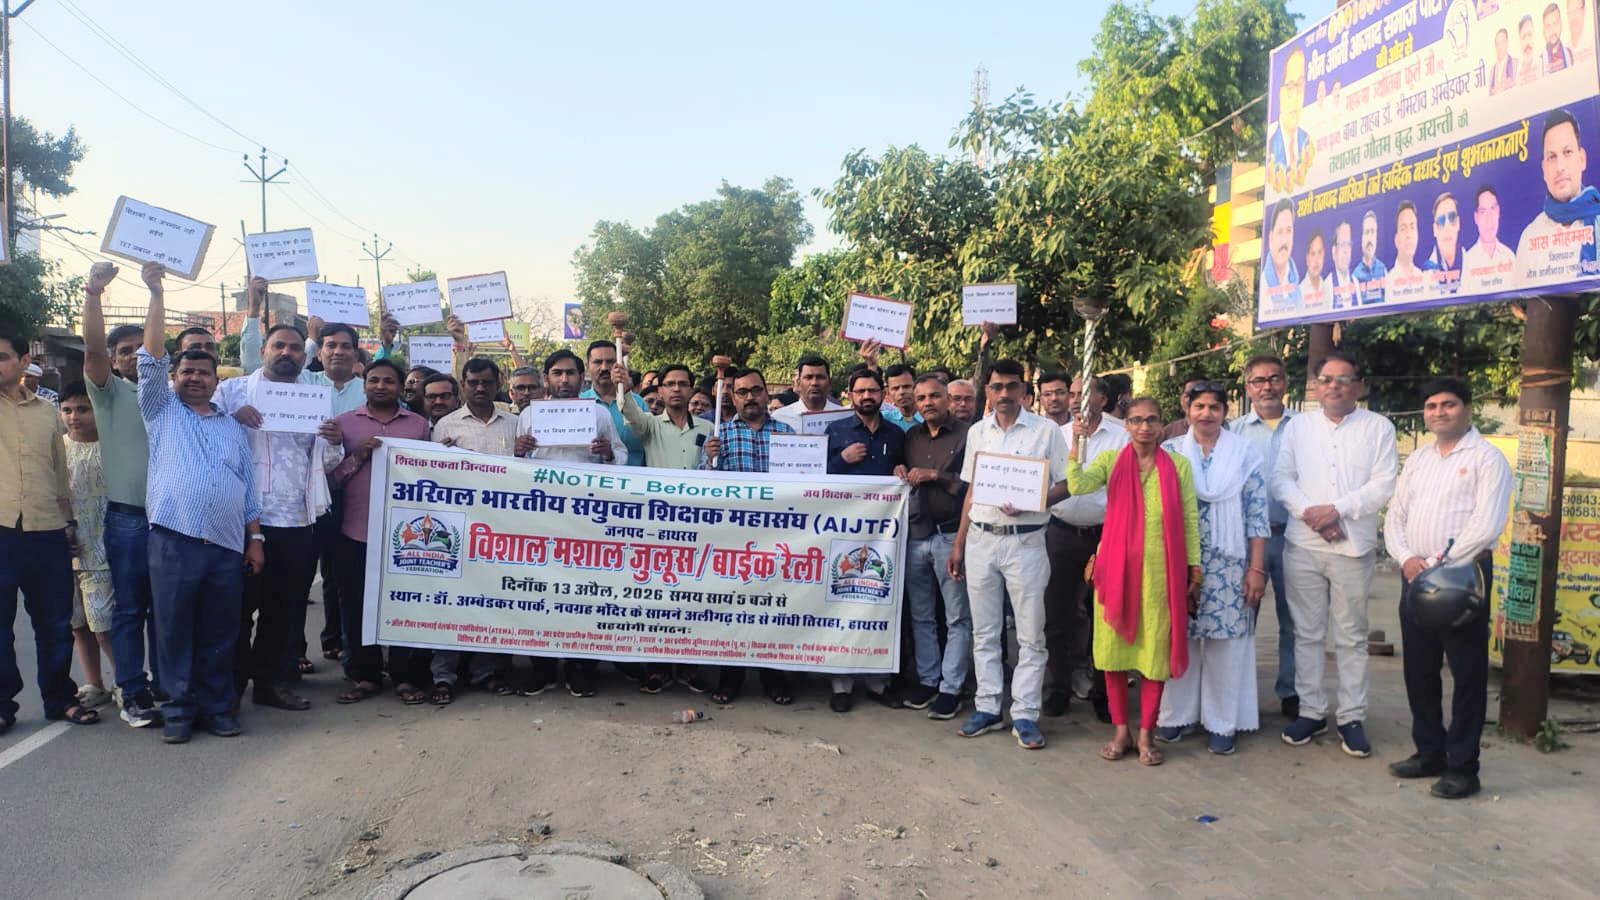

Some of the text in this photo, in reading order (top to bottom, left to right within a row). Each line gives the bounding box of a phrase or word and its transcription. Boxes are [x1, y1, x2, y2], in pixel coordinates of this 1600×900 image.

[1307, 49, 1326, 82] भीम
[1350, 20, 1382, 60] आजाद
[1384, 3, 1417, 40] समाज
[1376, 32, 1413, 68] की ओर से
[1425, 48, 1435, 76] जी
[1343, 120, 1357, 141] बाबा
[1396, 93, 1427, 119] भीमराव
[1431, 74, 1470, 106] अम्बेडकर
[1474, 58, 1486, 88] जी
[1329, 105, 1469, 174] तथागत गौतम बुद्ध जयन्ती की
[1368, 168, 1381, 196] को
[1382, 159, 1412, 193] हार्दिक
[1413, 147, 1442, 182] बधाई
[1442, 144, 1460, 184] एवं
[120, 240, 131, 249] TET
[1528, 235, 1549, 251] आस
[395, 454, 427, 468] शिक्षक
[430, 458, 459, 471] एकता
[533, 468, 774, 500] #NoTET_BeforeRTE
[803, 489, 819, 498] जय
[822, 488, 852, 499] शिक्षक
[864, 493, 879, 501] जय
[392, 480, 900, 538] अखिल भारतीय संयुक्त शिक्षक महासंघ (AIJTF)
[605, 525, 697, 542] जनपद हाथरस
[423, 551, 445, 559] INDIA
[468, 522, 549, 566] विशाल
[553, 534, 625, 568] मशाल
[777, 543, 826, 582] रैली
[552, 582, 571, 594] 13
[575, 581, 618, 600] अप्रैल,
[623, 586, 663, 600] 2026
[669, 590, 703, 602] समय
[707, 589, 733, 605] सायं
[737, 593, 746, 605] 5
[749, 594, 772, 606] बजे
[775, 593, 787, 608] से
[389, 590, 422, 602] स्थान
[433, 591, 453, 606] डॉ.
[456, 593, 515, 610] अम्बेडकर
[517, 598, 550, 614] पार्क,
[554, 602, 594, 615] नवग्रह
[630, 604, 642, 618] के
[645, 608, 682, 620] सामने
[736, 610, 755, 624] रोड
[758, 612, 769, 626] से
[802, 614, 845, 631] तिराहा,
[848, 619, 889, 632] हाथरस
[596, 621, 645, 632] सहयोगी
